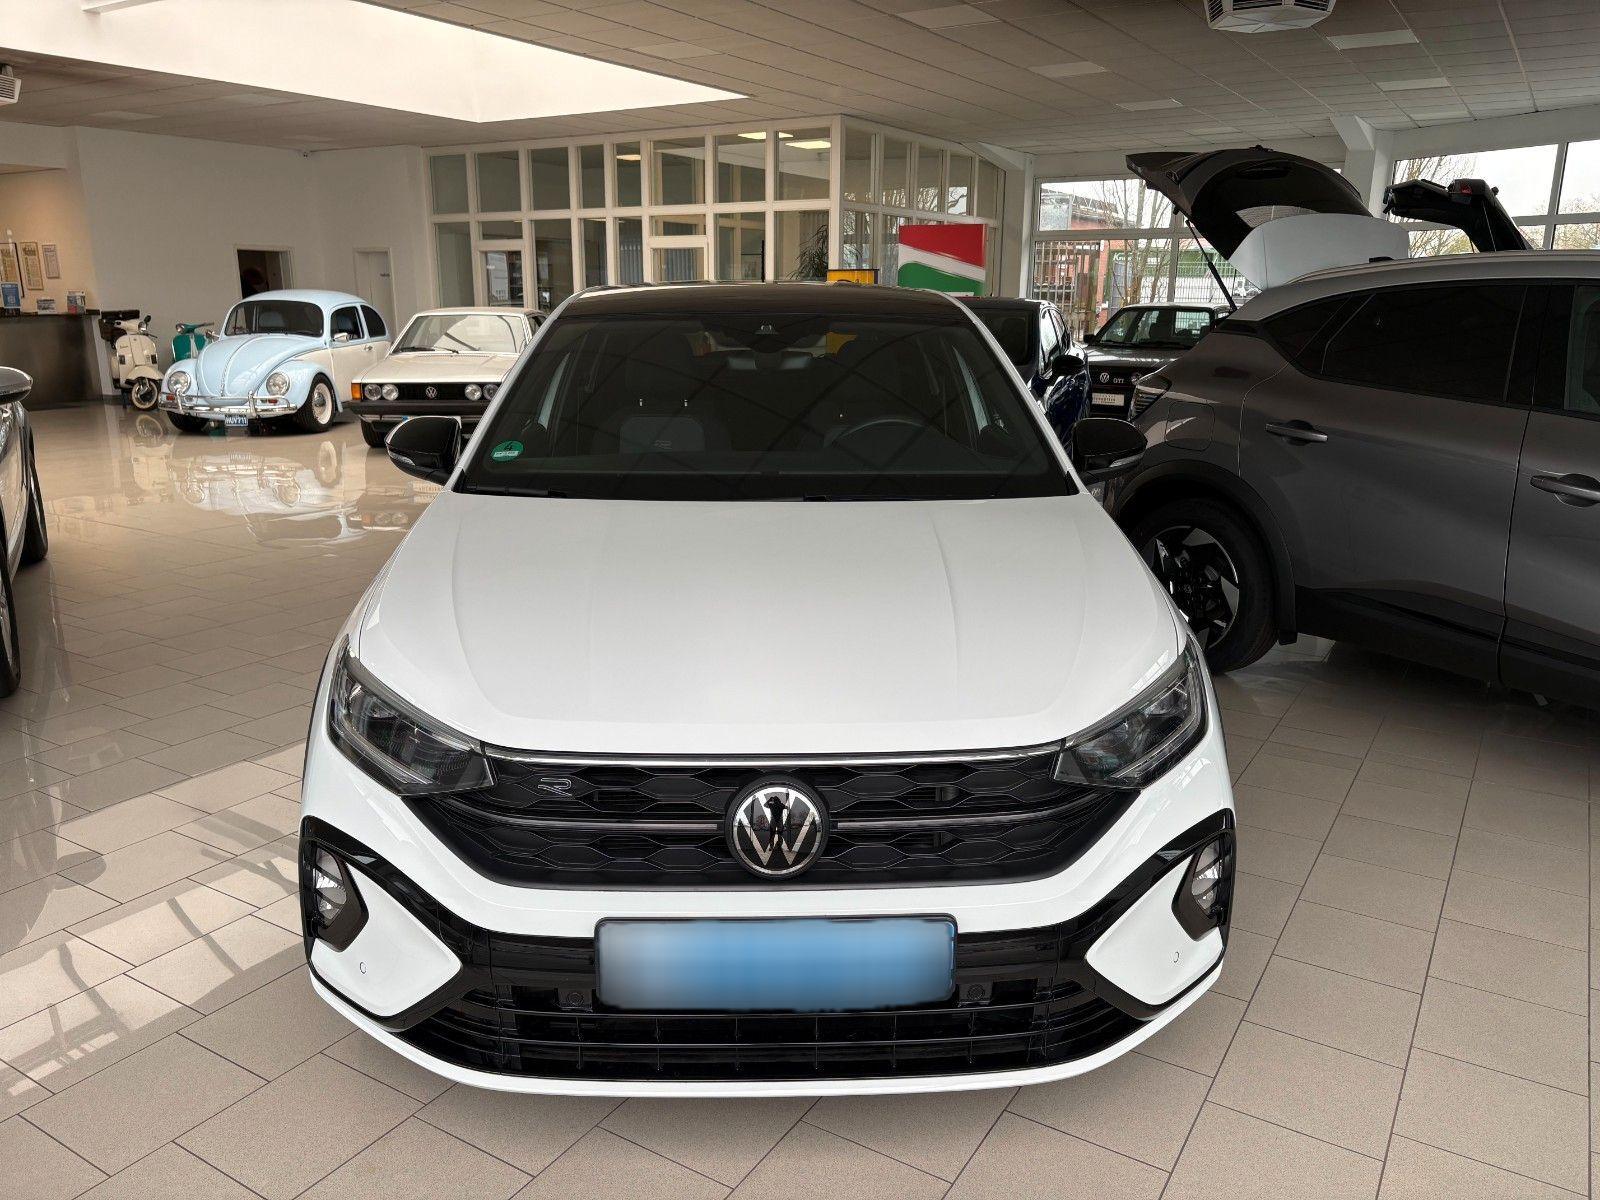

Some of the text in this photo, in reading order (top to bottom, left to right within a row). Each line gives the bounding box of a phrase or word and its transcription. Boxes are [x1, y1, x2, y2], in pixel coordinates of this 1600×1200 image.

[1100, 372, 1110, 383] VW
[425, 386, 438, 399] VW
[537, 777, 573, 797] R
[732, 785, 822, 876] VW
